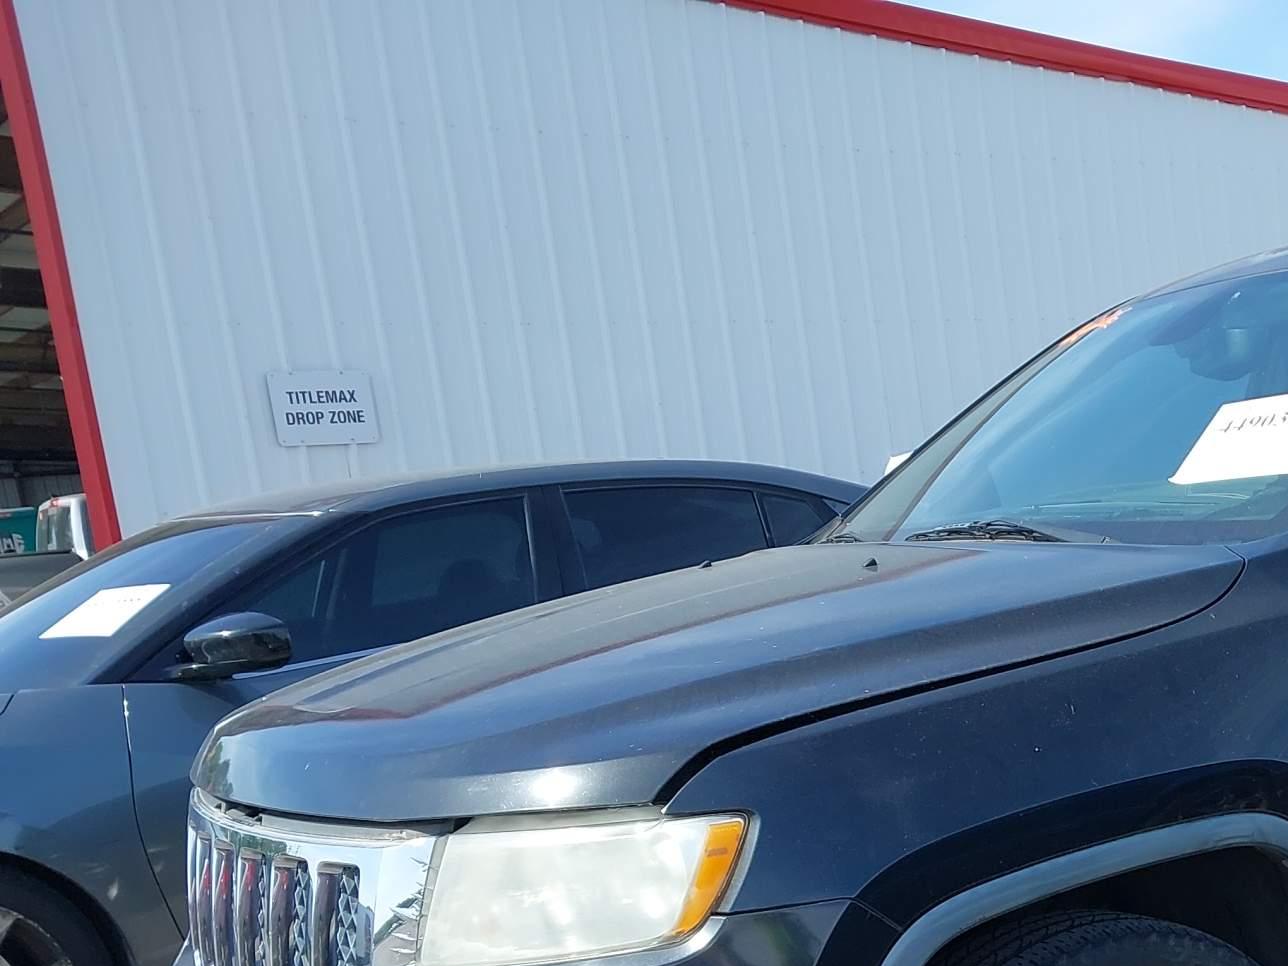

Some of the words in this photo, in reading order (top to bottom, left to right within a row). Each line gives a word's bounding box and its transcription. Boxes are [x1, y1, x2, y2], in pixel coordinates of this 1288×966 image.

[285, 389, 358, 405] TITLEMAX
[285, 411, 325, 426] DROP
[328, 409, 366, 425] ZONE
